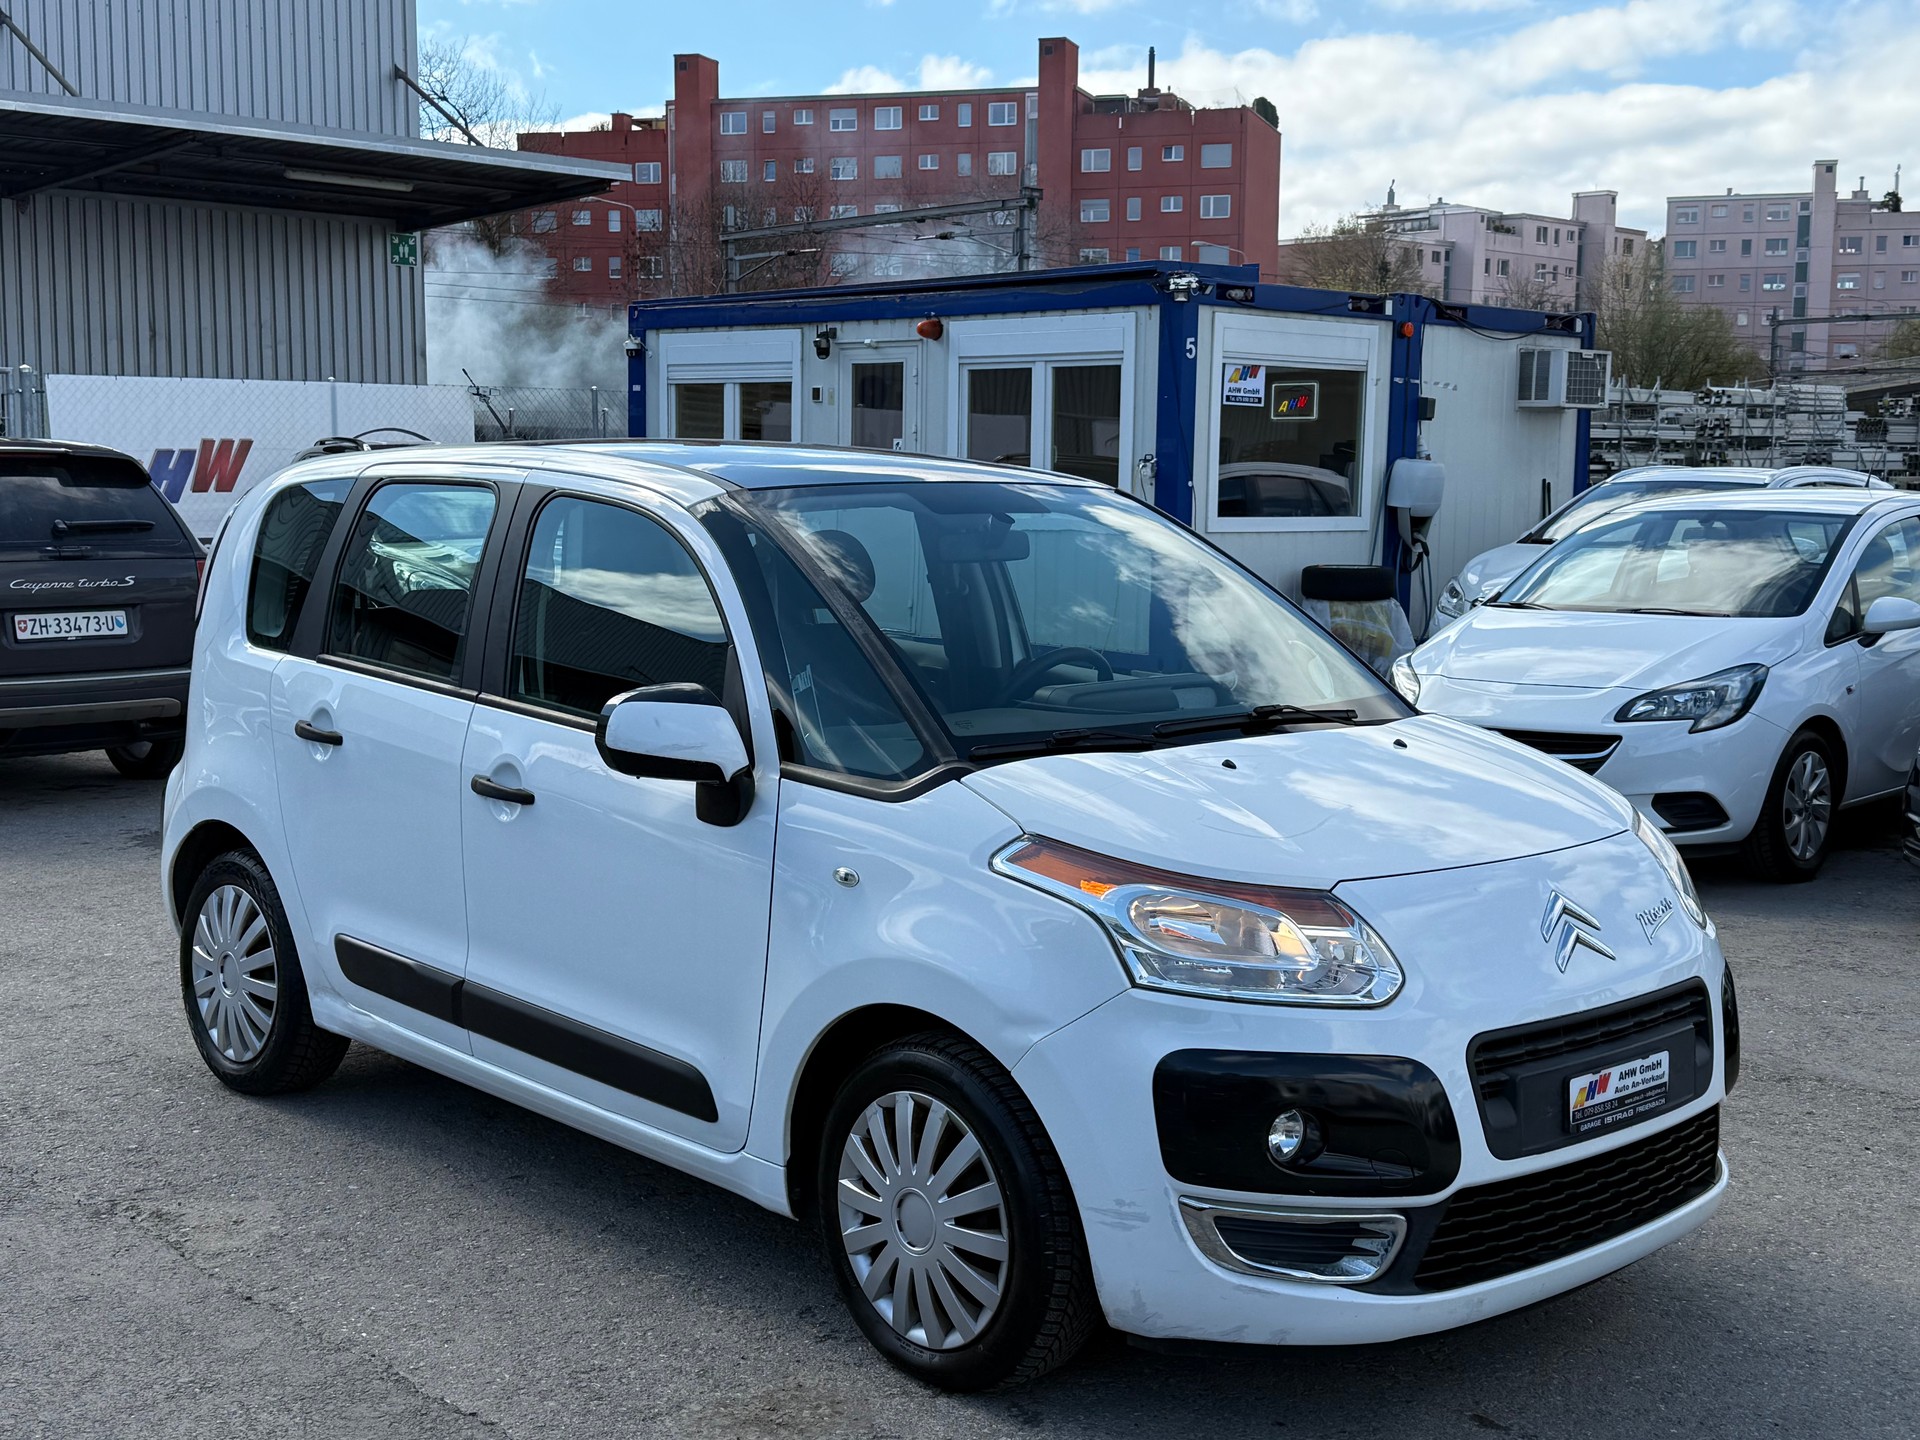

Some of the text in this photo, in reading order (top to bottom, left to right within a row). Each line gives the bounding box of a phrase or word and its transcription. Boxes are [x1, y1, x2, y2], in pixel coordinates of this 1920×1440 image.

[1186, 337, 1196, 359] 5
[1228, 365, 1261, 383] AHW
[1228, 386, 1242, 394] AHW
[1278, 395, 1309, 413] AHW
[138, 438, 254, 504] HW
[10, 579, 74, 593] Cayenne
[117, 575, 136, 586] S
[1618, 1059, 1662, 1082] AHW GmbH
[1572, 1072, 1611, 1110] AHW
[1614, 1070, 1666, 1095] Auto An-Verkauf
[1574, 1111, 1583, 1120] Tel.
[1584, 1107, 1594, 1118] 079
[1604, 1101, 1612, 1111] 58
[1580, 1097, 1666, 1132] GARAGE ISTRAG FREIENBACH
